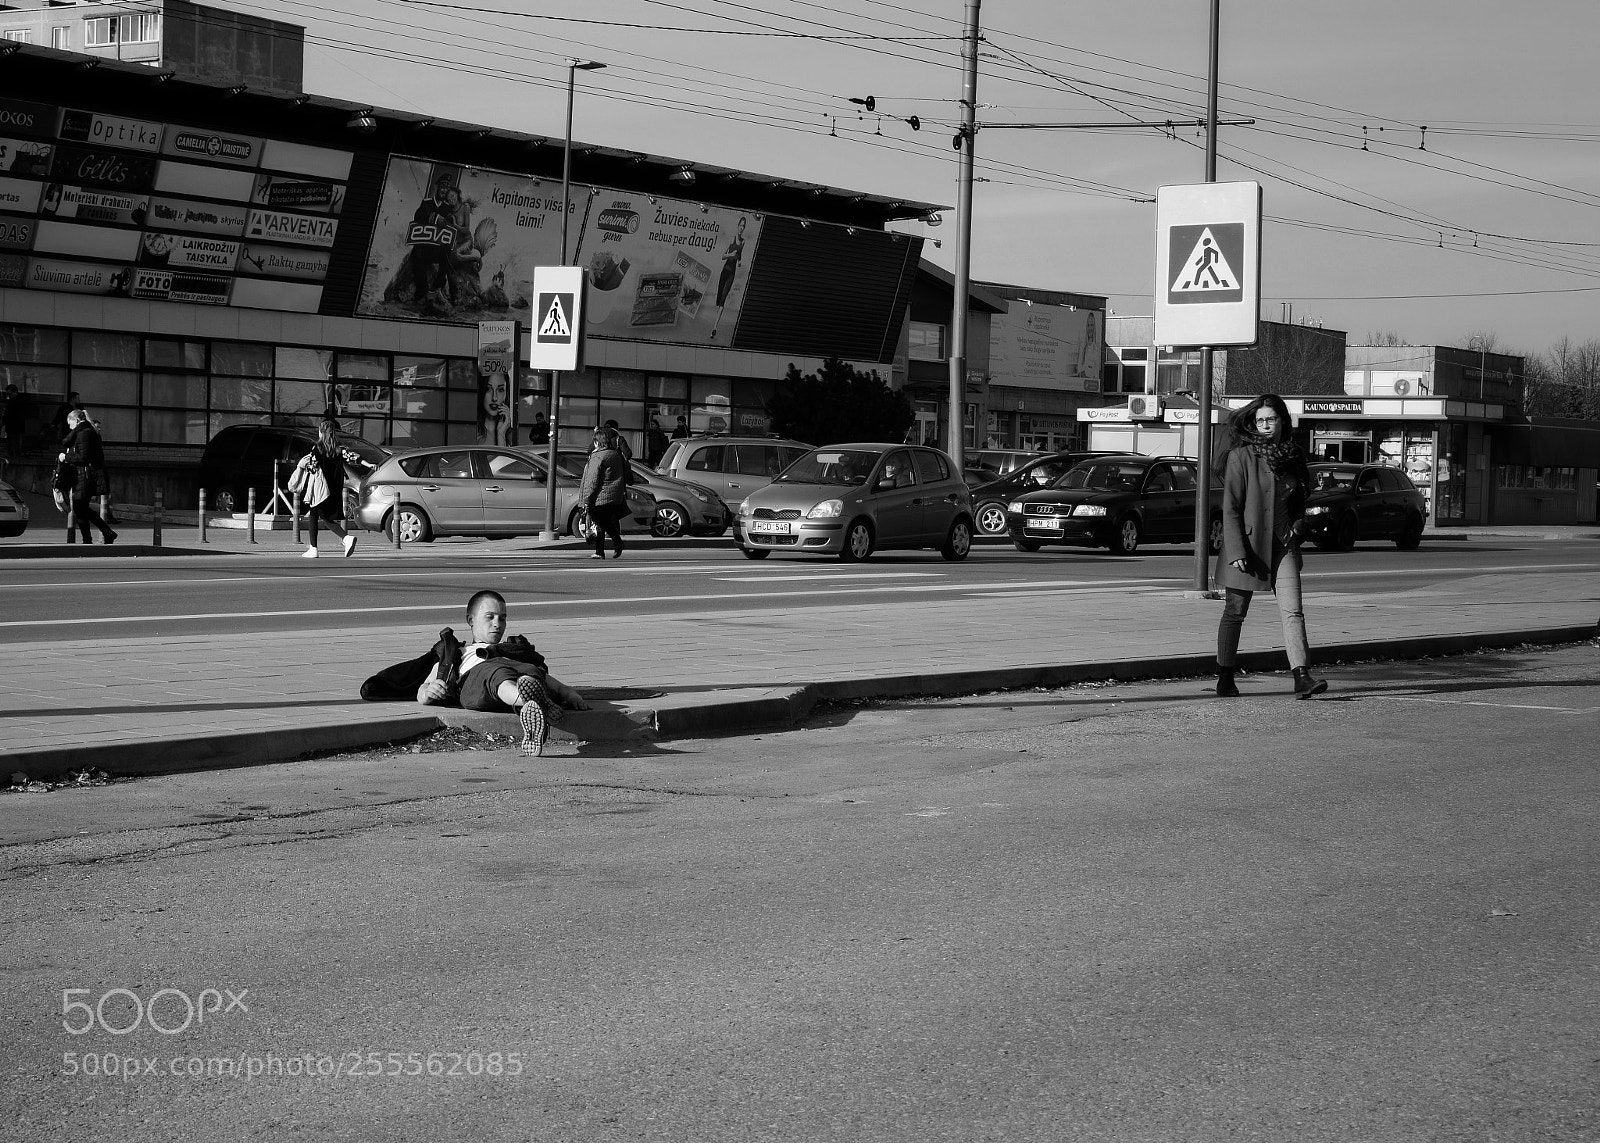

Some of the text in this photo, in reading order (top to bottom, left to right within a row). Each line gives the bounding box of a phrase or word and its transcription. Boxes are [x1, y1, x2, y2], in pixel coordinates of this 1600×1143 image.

[93, 120, 157, 144] Optika
[177, 135, 207, 150] CAMELIA
[78, 154, 128, 182] Gėlės
[491, 186, 541, 209] Kapitonas
[178, 211, 184, 219] ir
[220, 216, 245, 226] skyrius
[268, 215, 333, 237] ARVENTA
[515, 211, 545, 229] laimi!
[654, 205, 720, 233] Žuvies niekada
[601, 231, 623, 243] guru
[648, 230, 718, 252] nebus per daug!
[182, 240, 236, 256] LAIKRODŽIŲ
[186, 253, 228, 264] TAISYKLA
[268, 254, 327, 273] Raktų gamyba
[34, 264, 71, 284] Siuvimo
[73, 270, 102, 287] artelė
[139, 276, 171, 289] FOTO
[483, 360, 508, 373] -50%
[1305, 403, 1362, 411] KAUNO SPAUDA
